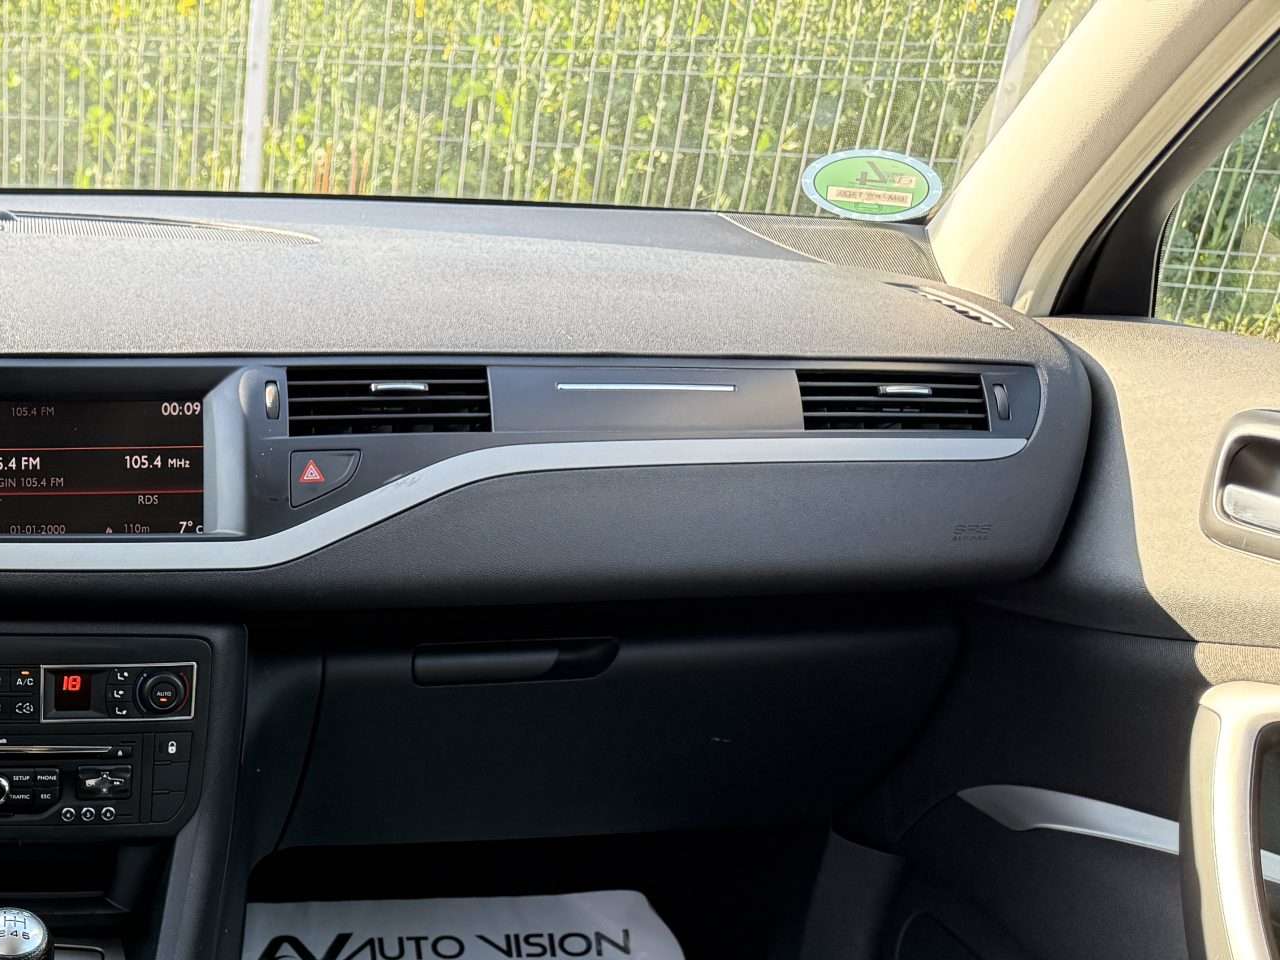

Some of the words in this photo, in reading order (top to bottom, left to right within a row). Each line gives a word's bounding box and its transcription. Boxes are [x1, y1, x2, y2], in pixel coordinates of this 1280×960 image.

[11, 406, 37, 417] 105.4
[40, 406, 55, 417] FM
[161, 402, 201, 416] 00:09
[21, 456, 40, 471] FM
[124, 455, 162, 470] 105.4
[167, 458, 190, 469] MHz
[20, 477, 47, 488] 105.4
[50, 477, 64, 488] FM
[137, 495, 159, 505] RDS
[9, 524, 66, 535] 01-01-2000
[123, 524, 150, 534] 110m
[16, 678, 34, 686] A/C
[63, 675, 81, 691] 18
[476, 928, 631, 960] VISION
